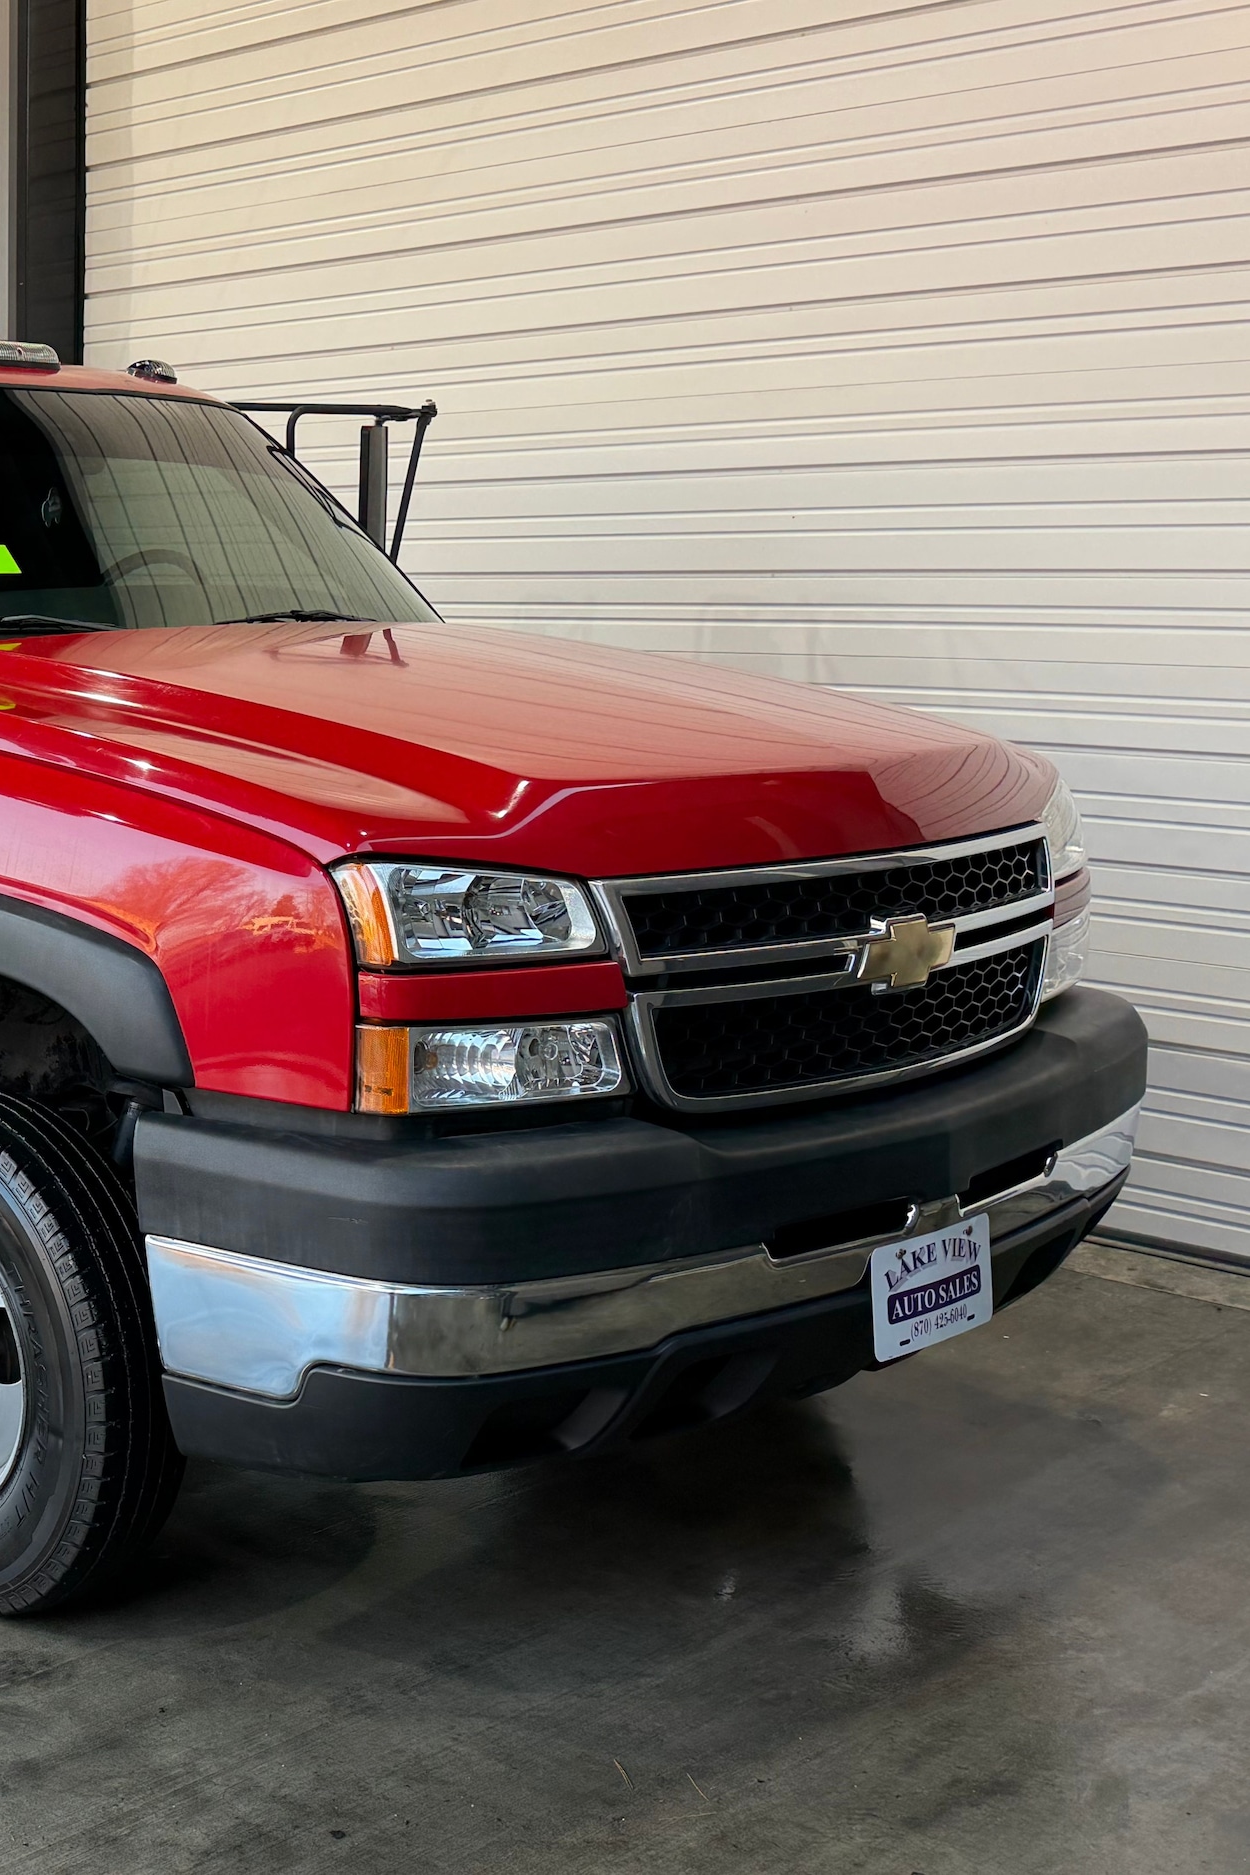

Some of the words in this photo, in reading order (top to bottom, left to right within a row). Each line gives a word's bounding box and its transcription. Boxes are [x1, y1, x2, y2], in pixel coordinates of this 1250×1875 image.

[883, 1241, 938, 1292] LAKE
[941, 1237, 982, 1264] VIEW
[891, 1288, 937, 1320] AUTO
[938, 1270, 979, 1304] SALES
[910, 1317, 933, 1341] (870)
[934, 1303, 969, 1330] 425-6040
